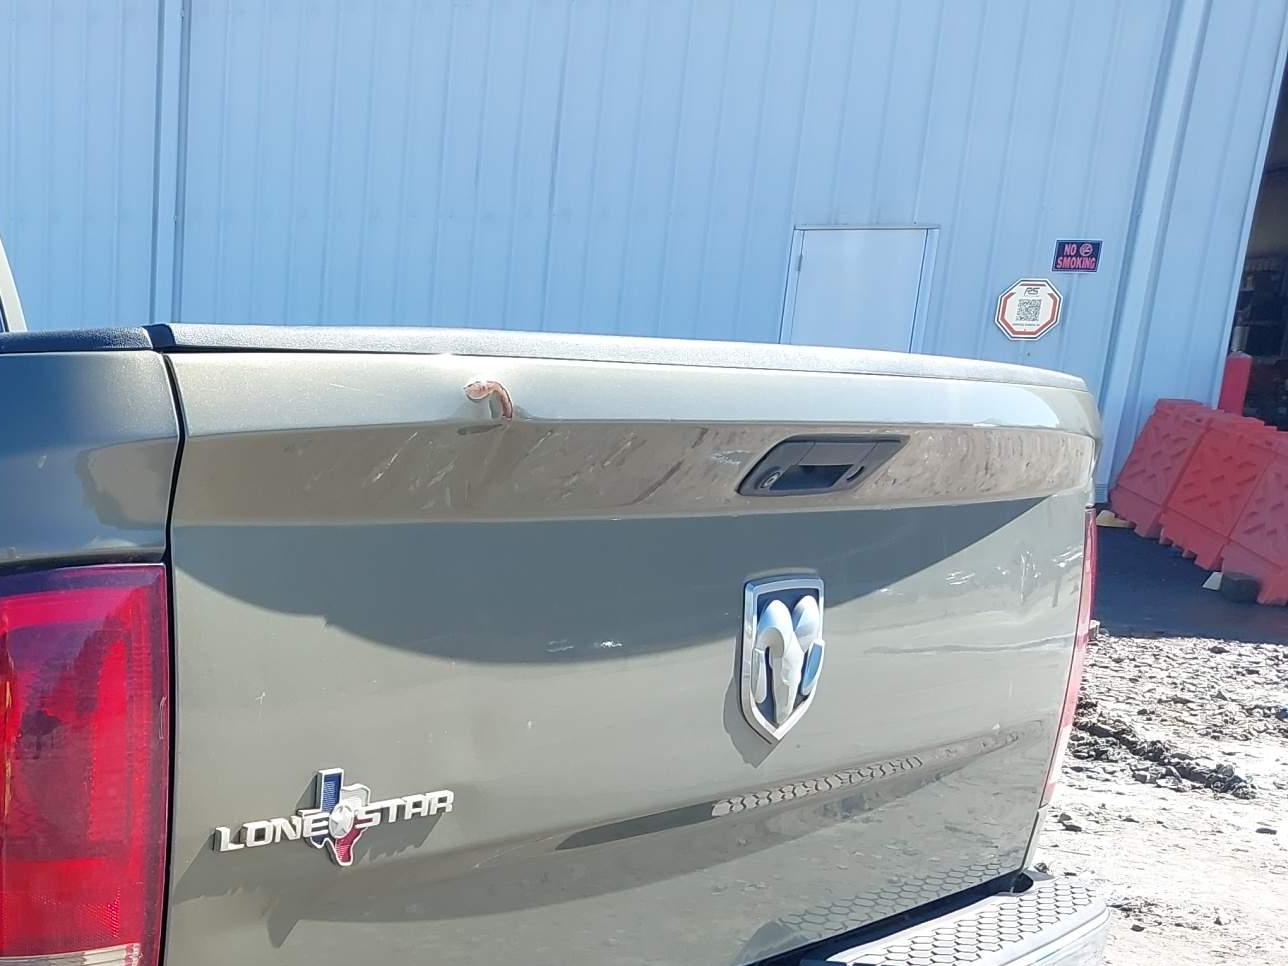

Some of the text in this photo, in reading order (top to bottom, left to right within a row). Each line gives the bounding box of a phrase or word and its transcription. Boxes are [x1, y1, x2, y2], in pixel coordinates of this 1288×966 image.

[1064, 243, 1077, 256] NO
[1056, 256, 1097, 269] SMOKING
[213, 789, 455, 853] LONE STAR
